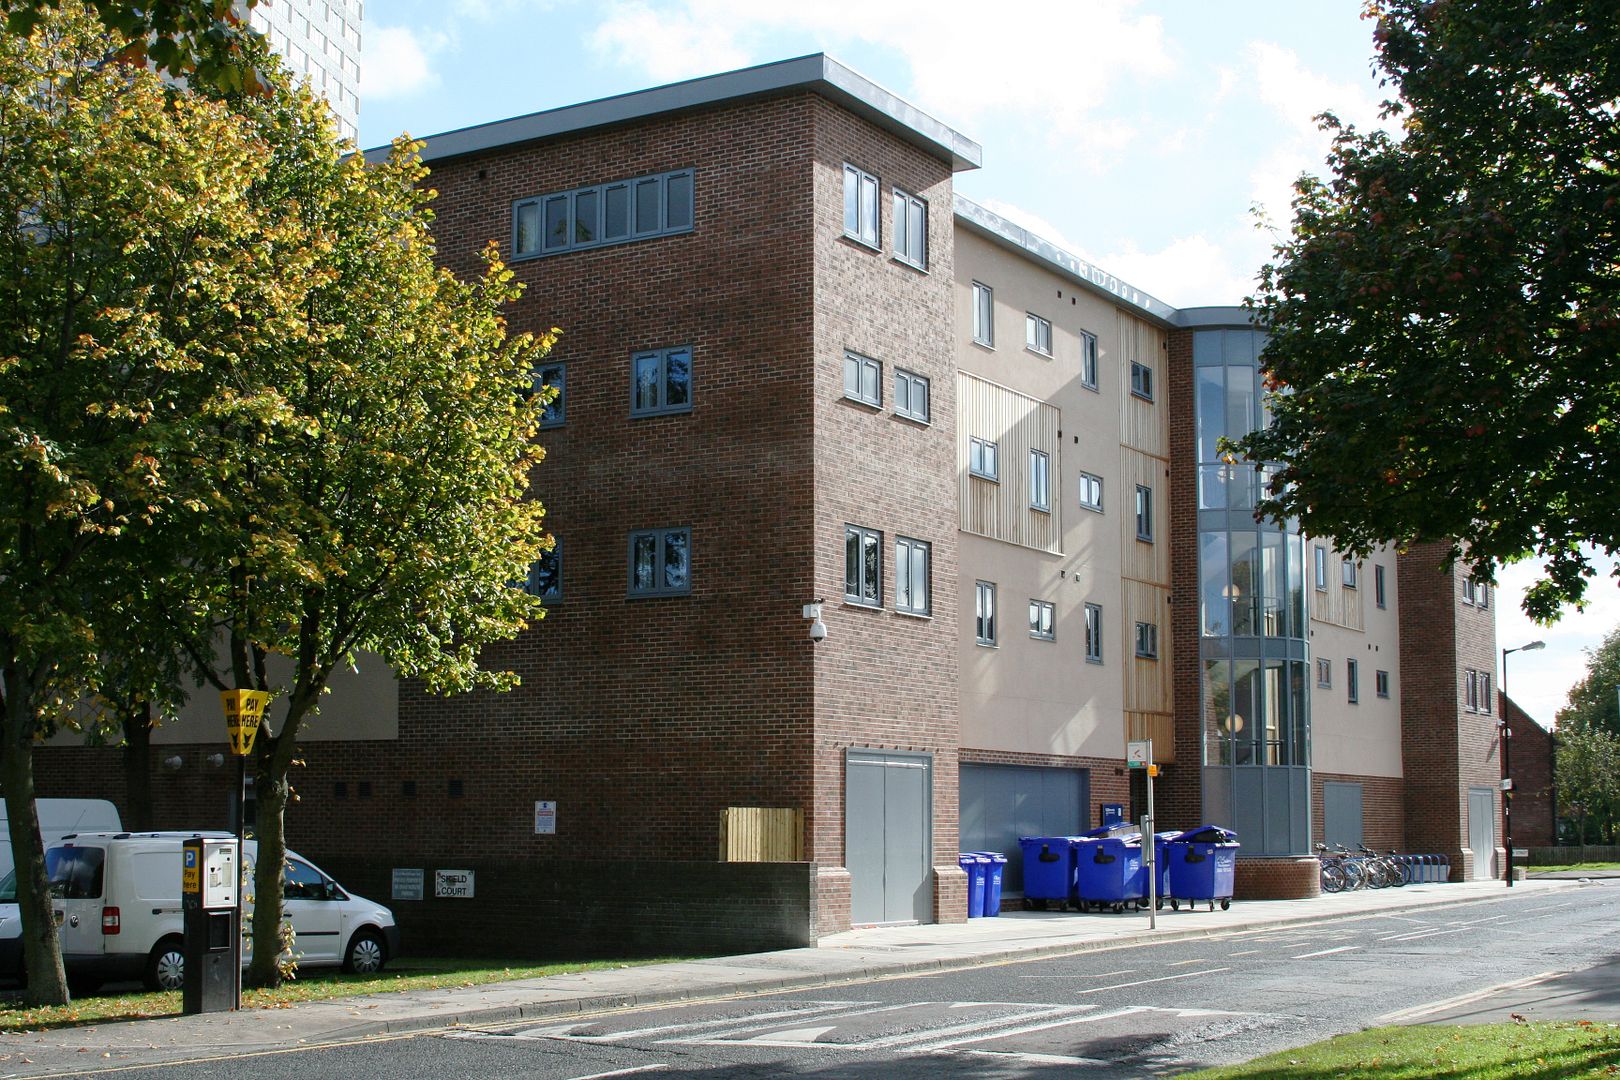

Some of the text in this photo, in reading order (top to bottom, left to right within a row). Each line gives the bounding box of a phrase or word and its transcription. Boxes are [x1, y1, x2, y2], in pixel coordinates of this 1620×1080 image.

[246, 698, 259, 711] PAY
[241, 714, 259, 728] HERE
[186, 852, 194, 867] P
[441, 886, 467, 896] COURT
